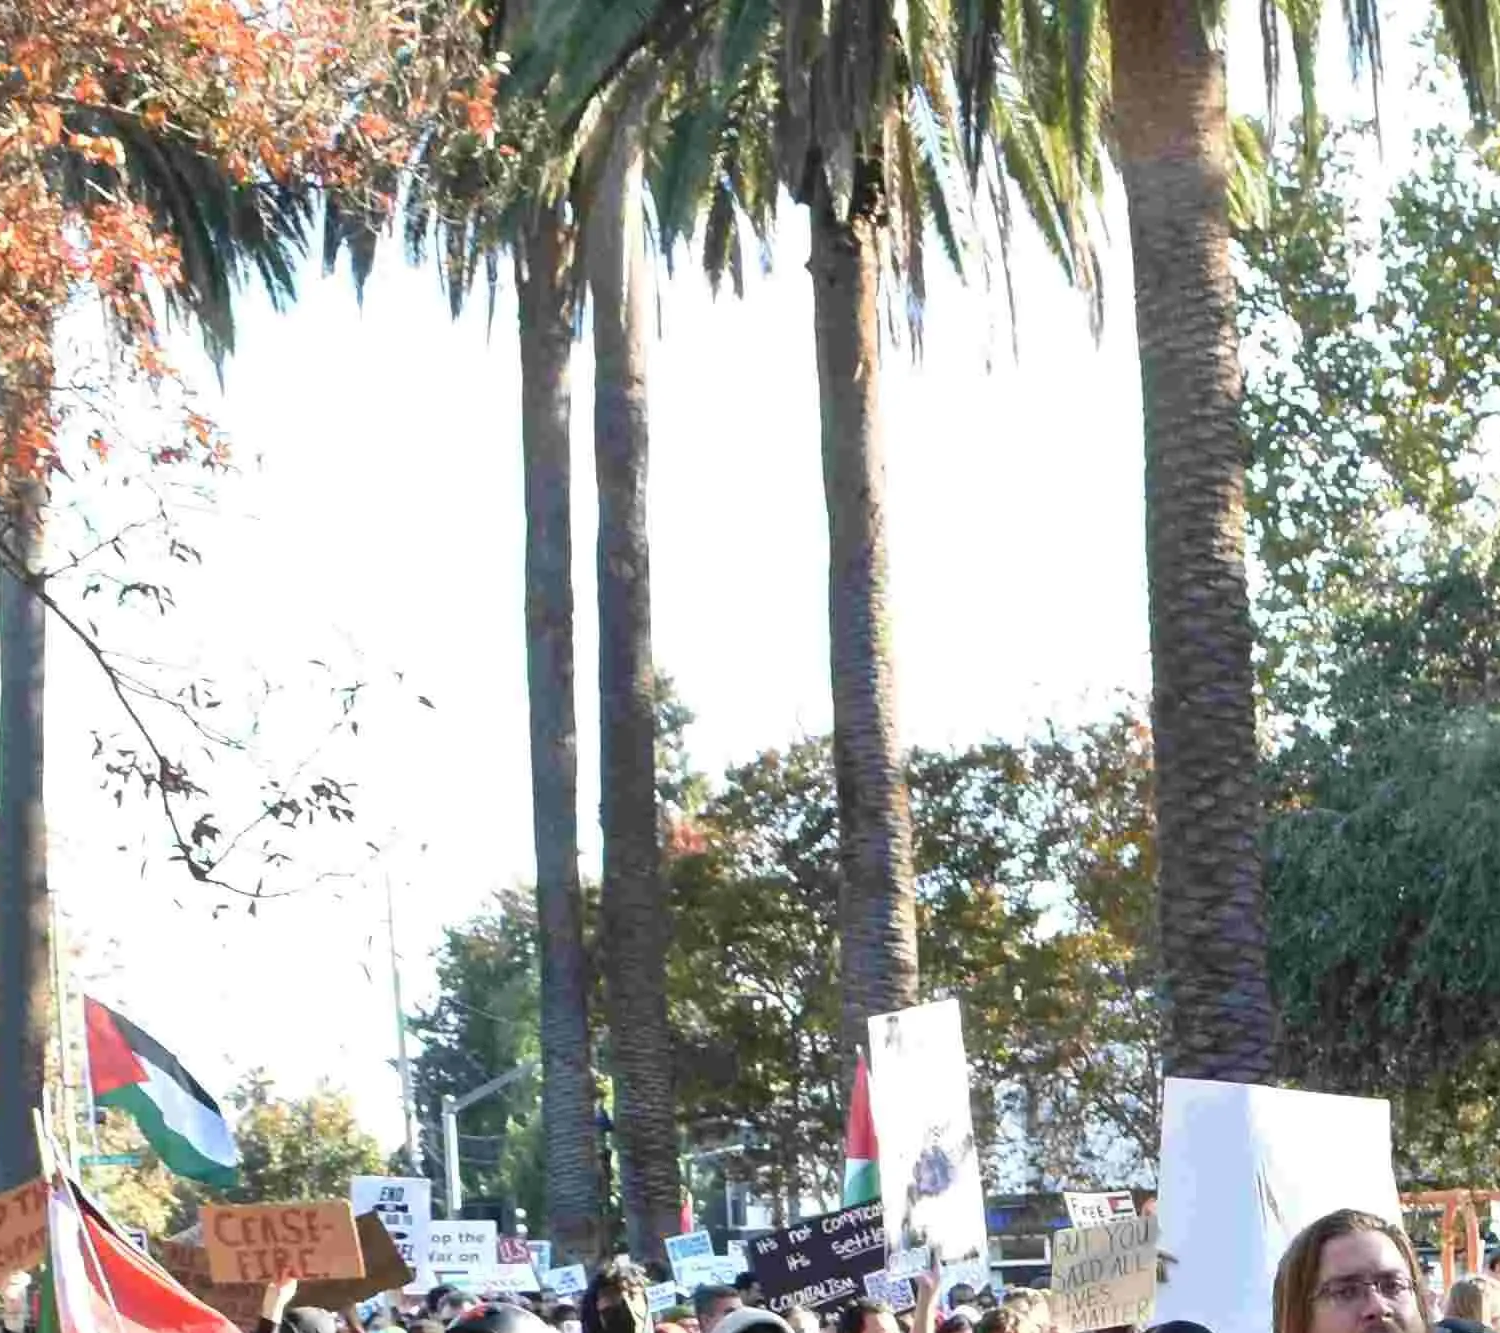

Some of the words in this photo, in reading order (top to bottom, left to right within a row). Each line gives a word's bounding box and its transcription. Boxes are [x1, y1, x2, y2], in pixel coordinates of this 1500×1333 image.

[213, 1209, 333, 1247] CEASE-
[457, 1230, 486, 1244] the
[788, 1225, 813, 1245] not
[1054, 1228, 1090, 1257] BUT
[1104, 1219, 1149, 1255] YOU
[459, 1252, 480, 1264] on
[1112, 1253, 1149, 1278] ALL
[1071, 1299, 1150, 1328] MATTER
